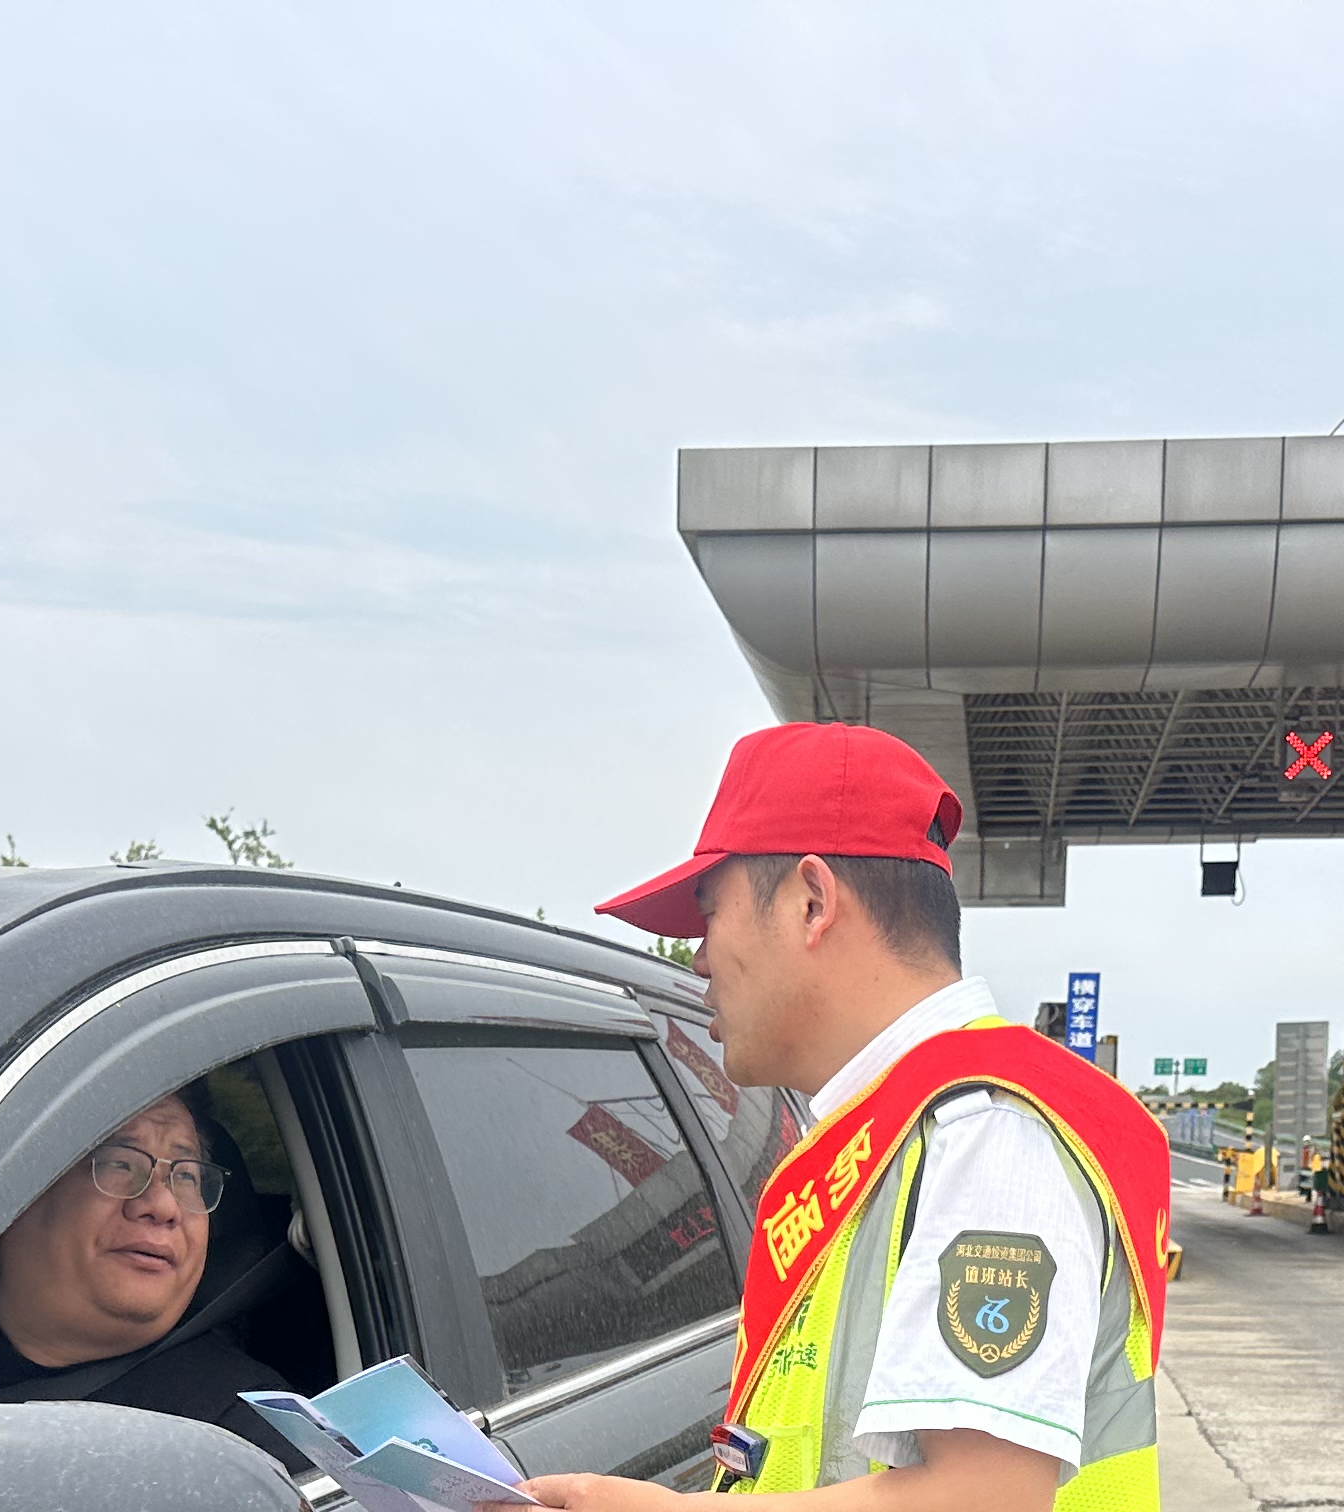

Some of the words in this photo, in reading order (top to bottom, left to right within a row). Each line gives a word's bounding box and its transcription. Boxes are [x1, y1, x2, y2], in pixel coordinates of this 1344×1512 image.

[1069, 979, 1097, 1048] 横穿车道
[965, 1265, 1029, 1290] 值班站长
